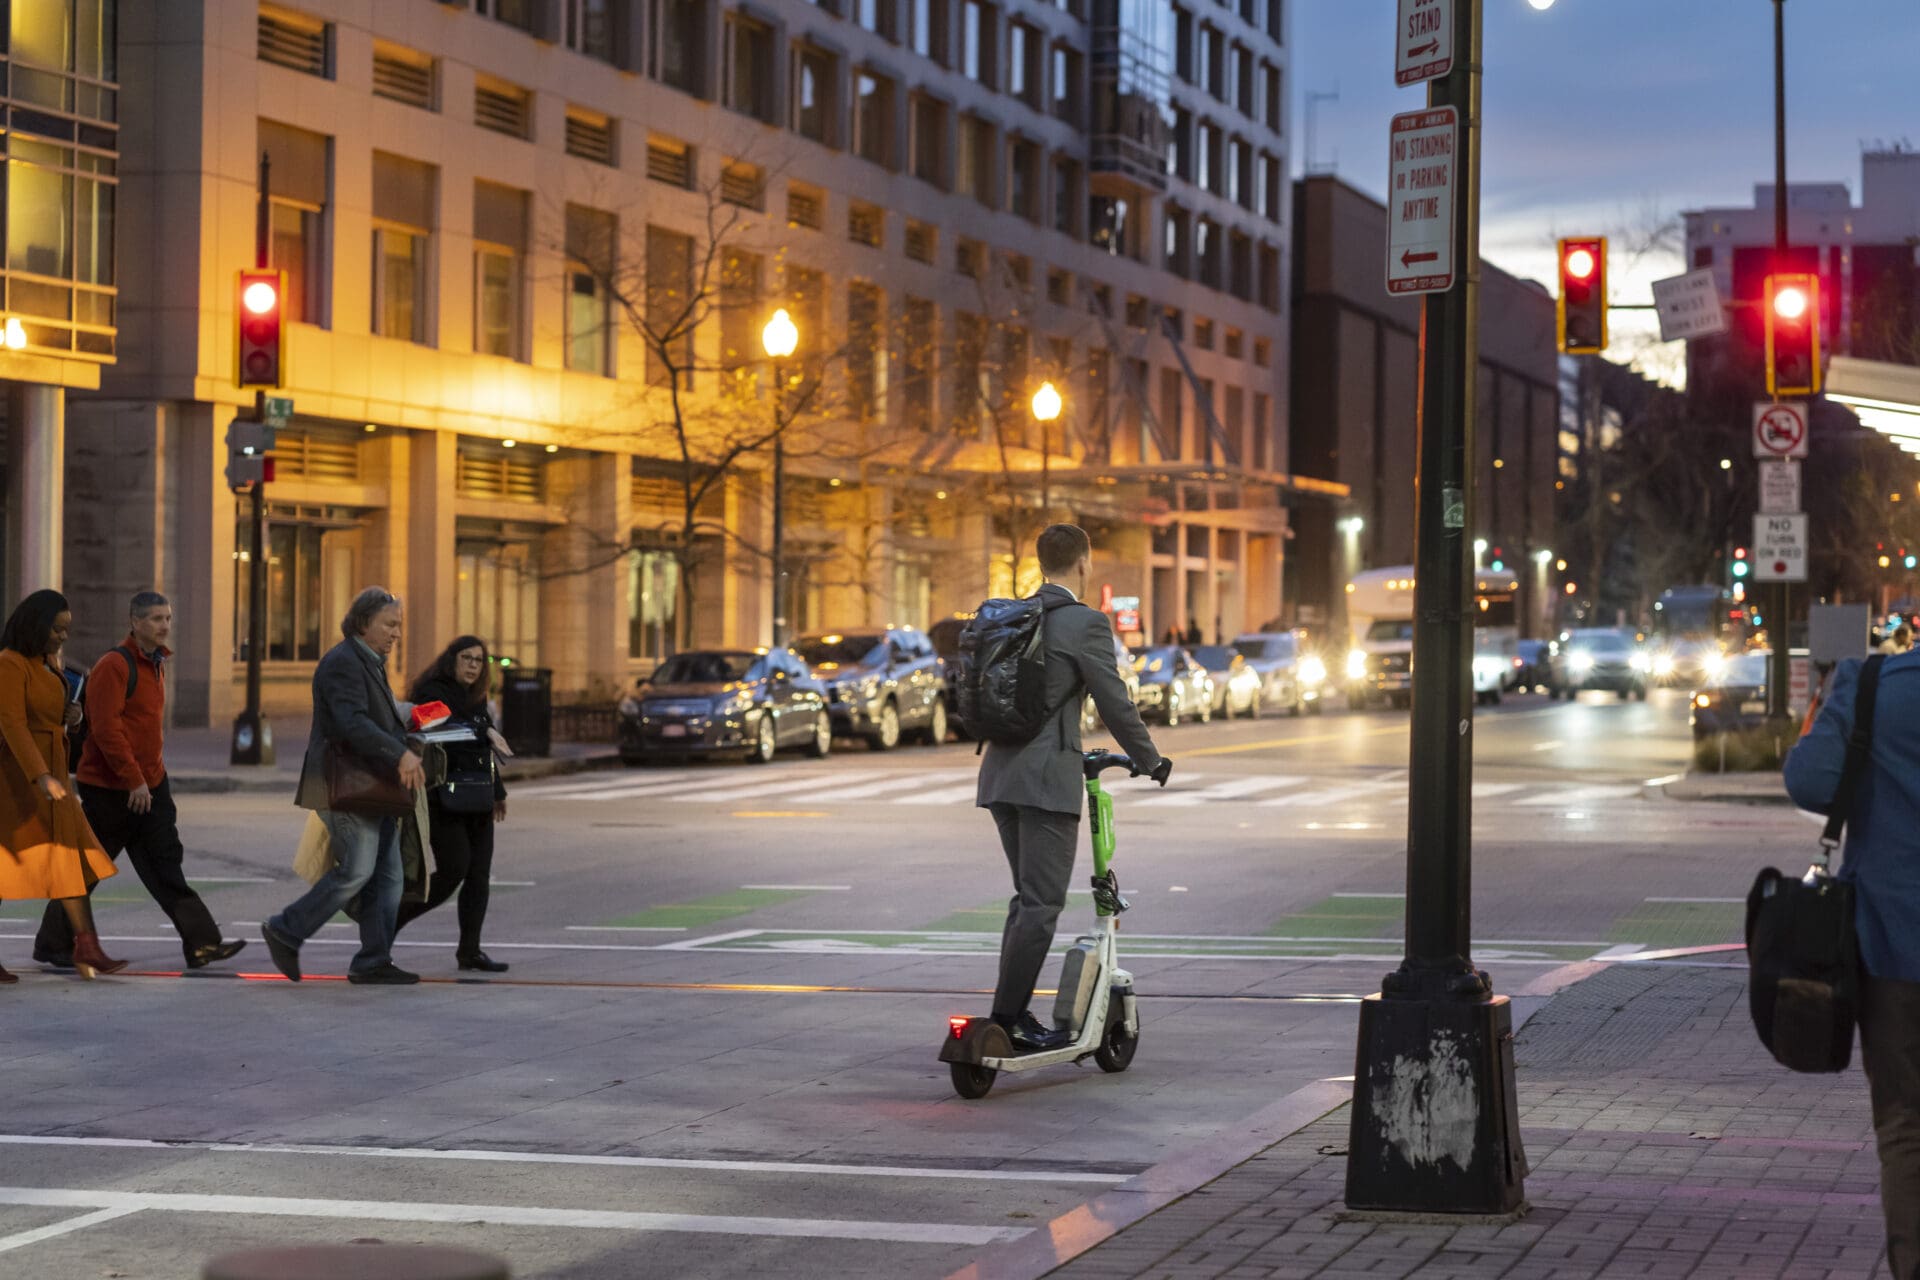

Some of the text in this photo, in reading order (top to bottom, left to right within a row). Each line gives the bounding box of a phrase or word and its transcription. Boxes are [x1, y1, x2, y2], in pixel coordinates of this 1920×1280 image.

[1408, 7, 1441, 39] STAND
[1424, 112, 1447, 126] AWAY
[1395, 133, 1451, 161] NO STANDING
[1397, 163, 1447, 190] OR PARKING
[1403, 196, 1439, 222] ANYTIME
[1670, 296, 1705, 313] MUST
[1768, 519, 1792, 532] NO
[1766, 533, 1796, 544] TURN
[1758, 546, 1801, 558] ON RED
